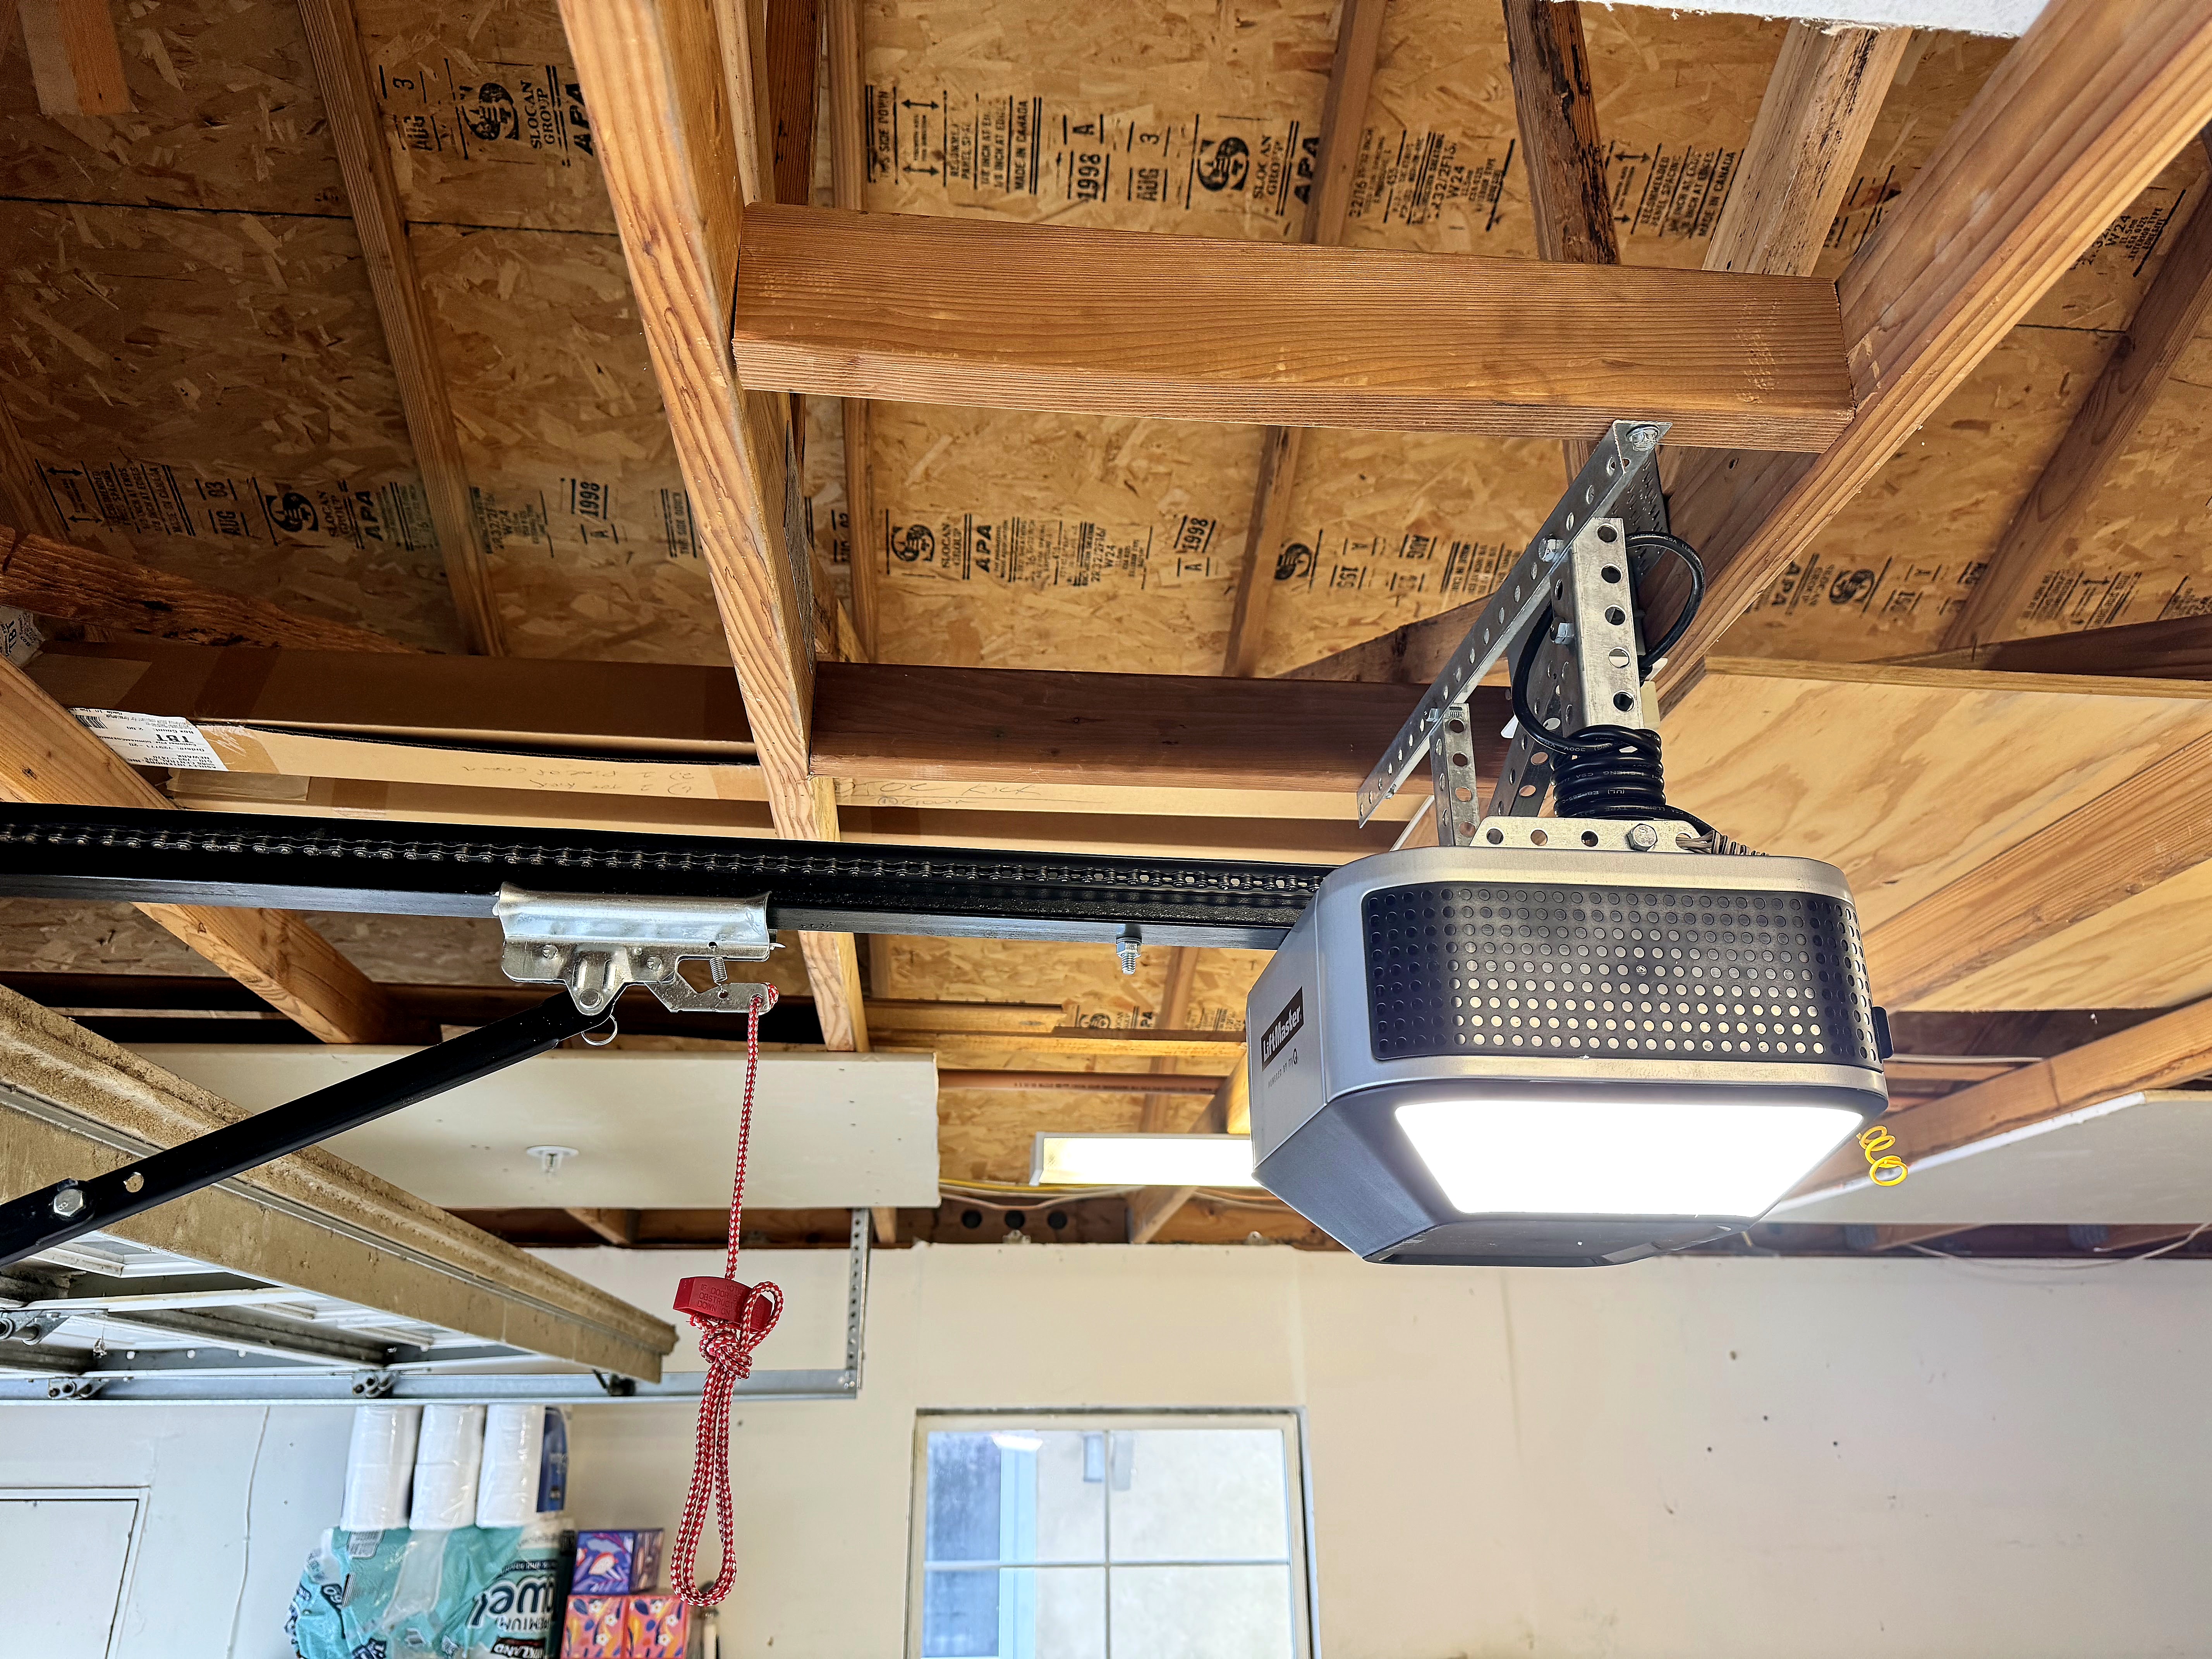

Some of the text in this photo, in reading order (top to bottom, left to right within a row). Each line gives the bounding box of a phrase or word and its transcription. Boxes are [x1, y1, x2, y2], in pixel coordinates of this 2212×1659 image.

[393, 79, 414, 90] 3
[520, 80, 542, 149] SLOCAN
[536, 88, 555, 145] GROUP
[565, 83, 594, 156] APA
[1072, 123, 1095, 136] A
[403, 115, 433, 151] AUG
[1014, 101, 1028, 190] MADE IN CANADA
[1139, 132, 1160, 145] 3
[1077, 153, 1101, 199] 1998
[1137, 167, 1159, 202] AUG
[1253, 135, 1271, 199] SLOCAN
[1266, 141, 1283, 195] GROUP
[1294, 137, 1319, 204] APA
[1446, 166, 1465, 199] W24
[1714, 151, 1736, 192] CANADA
[2104, 215, 2131, 247] W24
[355, 491, 383, 541] APA
[579, 481, 600, 517] 1998
[216, 510, 241, 536] AUG
[1182, 518, 1208, 551] 1998
[941, 523, 951, 568] SLOCAN
[975, 525, 992, 573] APA
[1407, 534, 1430, 559] AUG
[1184, 563, 1202, 571] A
[1772, 561, 1802, 606] APA
[5, 620, 16, 654] TBT
[156, 734, 194, 743] TBT
[1140, 1012, 1152, 1028] PA
[1263, 1005, 1300, 1062] LiftMaster
[697, 1300, 731, 1316] DOWN ON
[711, 1286, 729, 1298] DOOR
